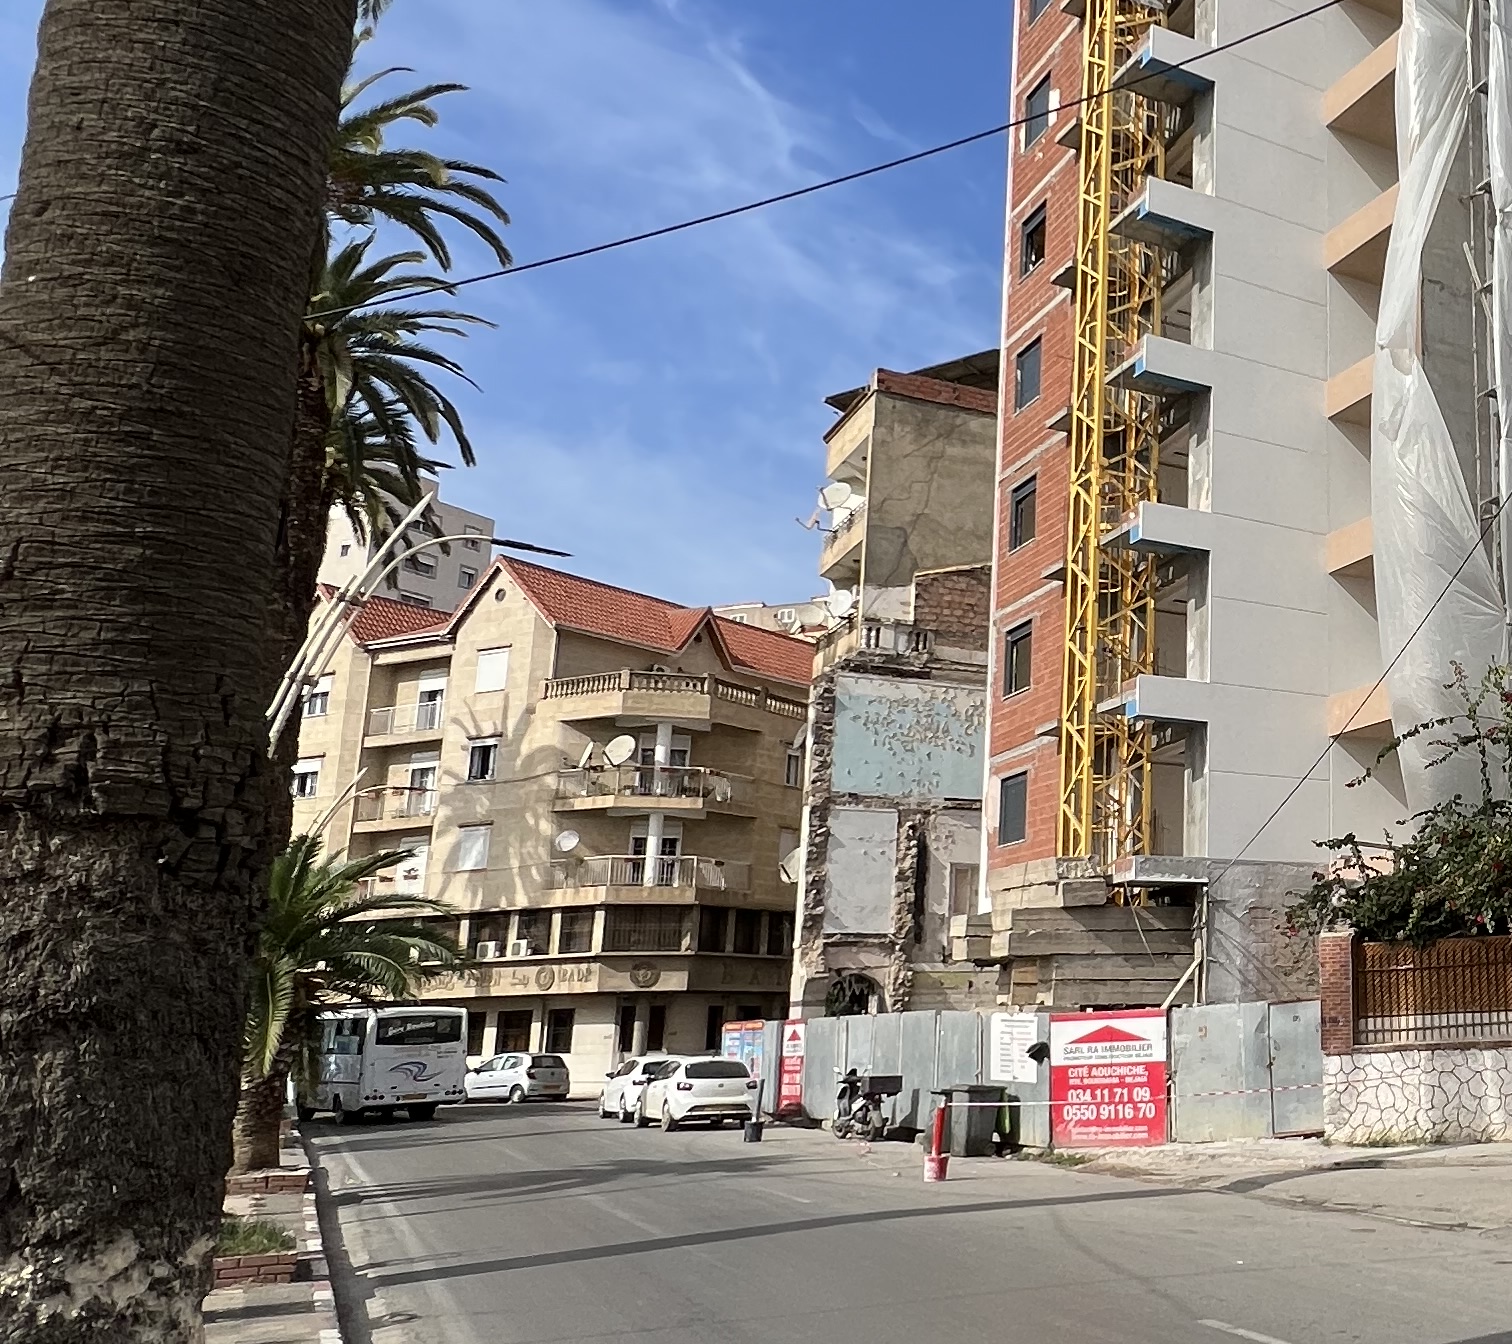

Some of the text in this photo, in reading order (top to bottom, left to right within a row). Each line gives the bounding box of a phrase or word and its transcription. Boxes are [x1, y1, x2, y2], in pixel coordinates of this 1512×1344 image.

[1063, 1043, 1153, 1055] SARL RA IMMOBILIER
[1068, 1065, 1149, 1078] CITÉ AOUCHICHE,
[1113, 1088, 1128, 1102] 71
[1133, 1087, 1151, 1102] 09
[1063, 1104, 1097, 1120] 0550
[1137, 1102, 1156, 1118] 70
